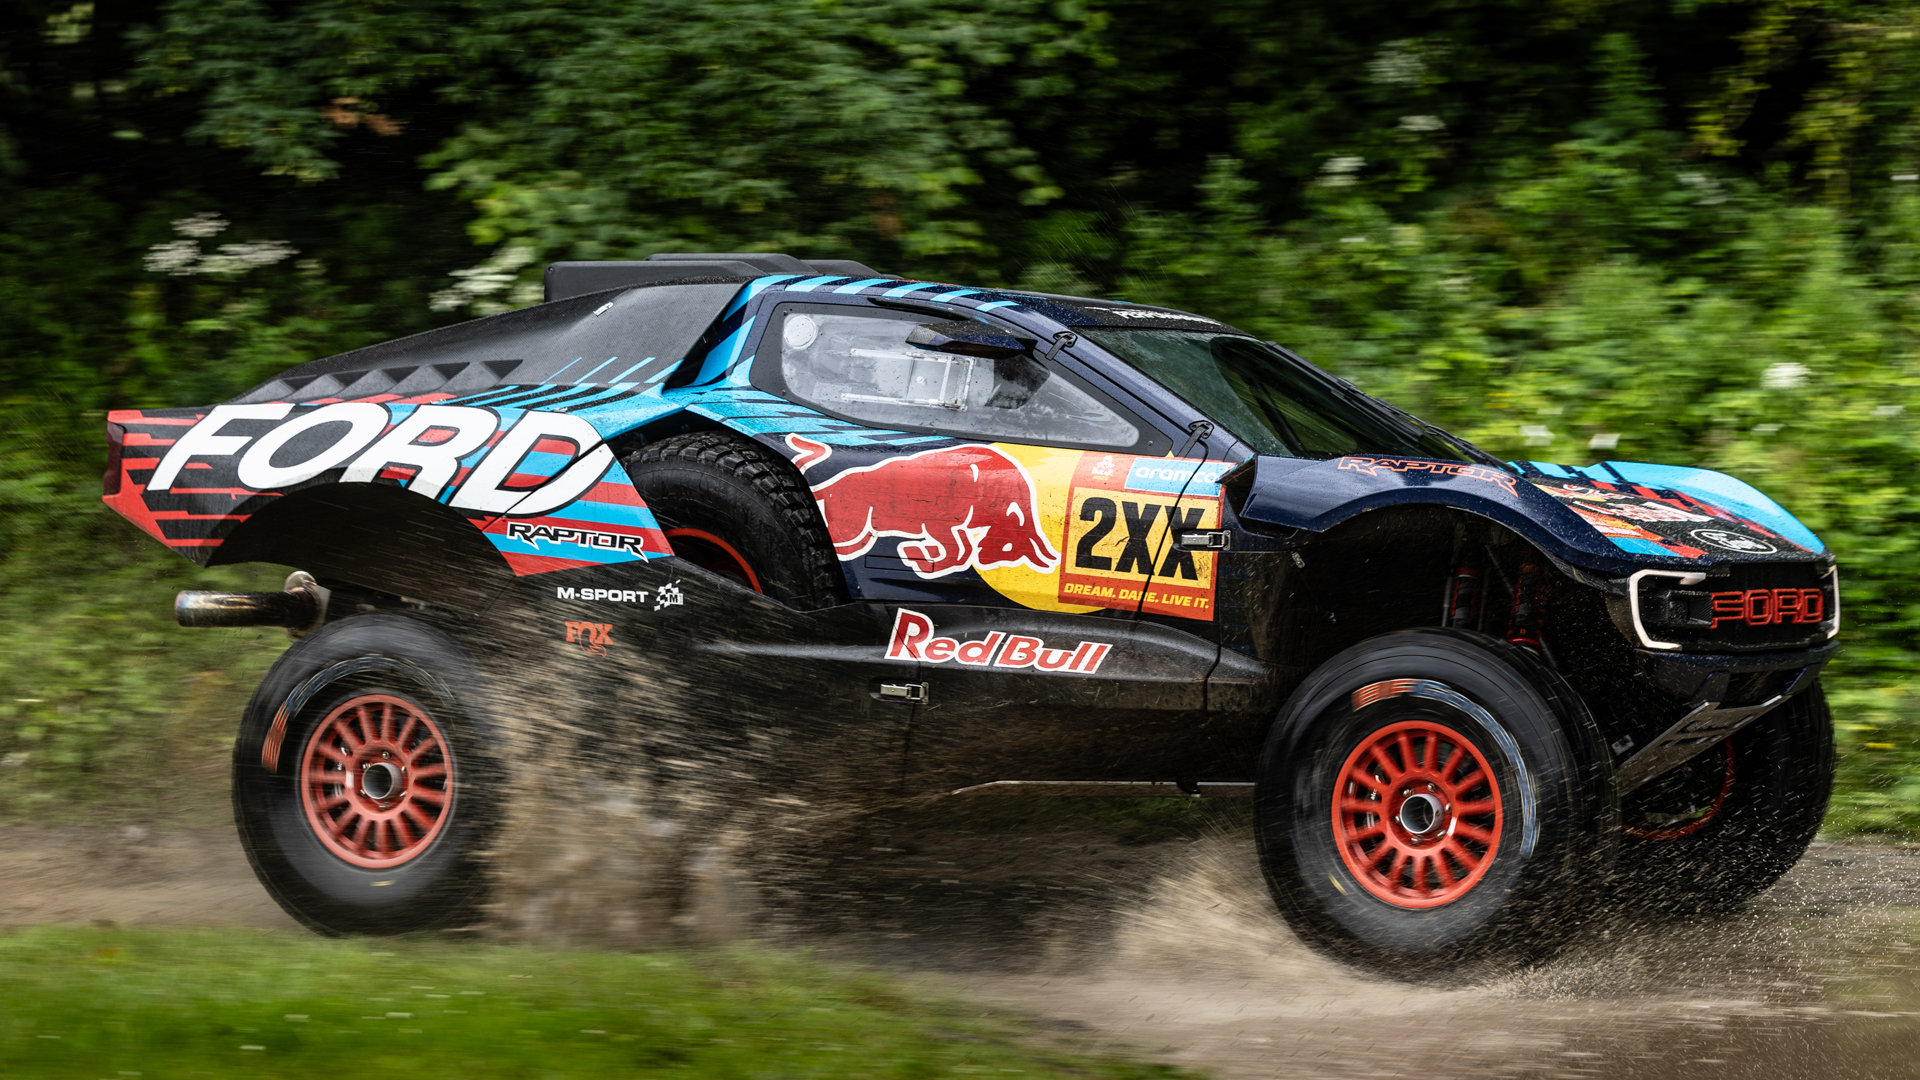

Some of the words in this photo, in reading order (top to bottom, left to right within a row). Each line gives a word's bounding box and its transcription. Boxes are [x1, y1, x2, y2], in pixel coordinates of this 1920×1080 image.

[147, 403, 614, 517] FORD
[1135, 466, 1219, 484] aramco
[1338, 456, 1519, 498] RAPTOR
[507, 521, 649, 563] RAPTOR
[1075, 496, 1206, 581] 2XX
[557, 586, 649, 603] M-SPORT
[1063, 583, 1117, 598] DREAM.
[1118, 588, 1159, 603] DARE.
[1161, 593, 1193, 608] LIVE
[1193, 597, 1210, 609] IT.
[1708, 588, 1824, 630] FORD
[565, 621, 614, 647] FOX
